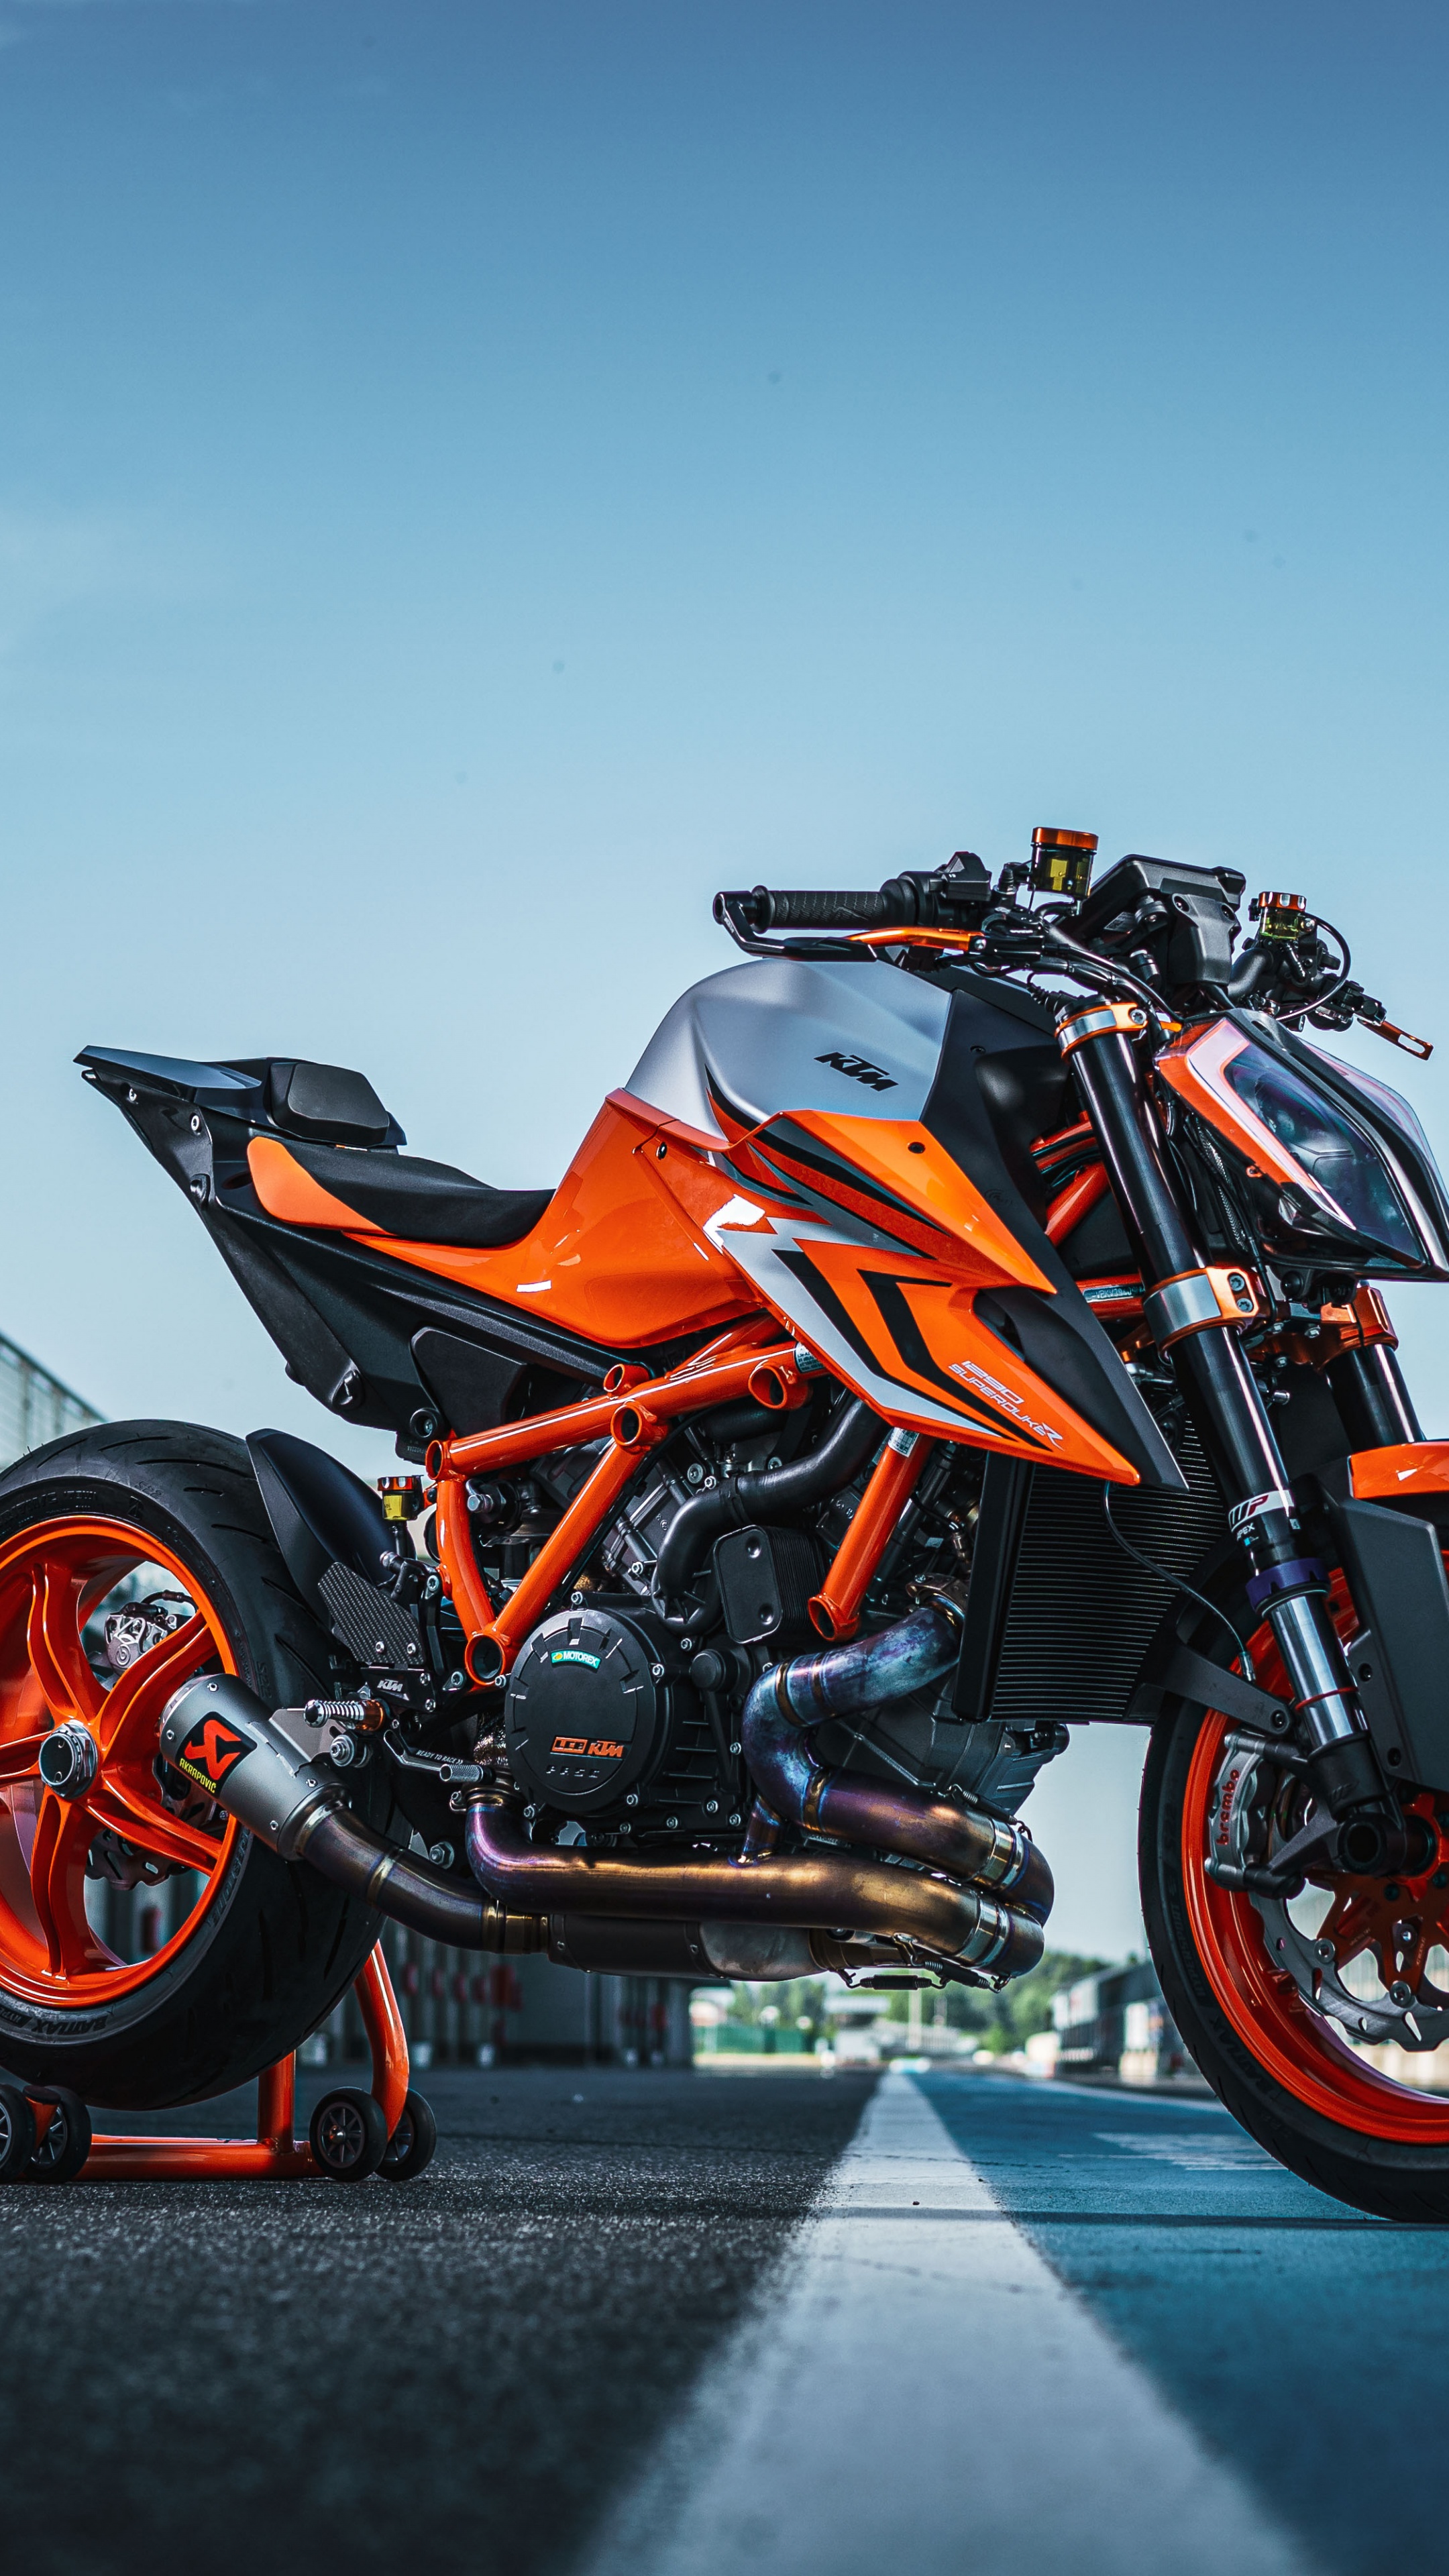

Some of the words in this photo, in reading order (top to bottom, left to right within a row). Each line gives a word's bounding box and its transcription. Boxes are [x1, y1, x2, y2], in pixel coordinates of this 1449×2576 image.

[813, 1052, 899, 1091] KTM
[961, 1360, 1024, 1404] 1290
[563, 1650, 598, 1667] MOTOREX
[377, 1679, 403, 1692] KTM
[416, 1750, 435, 1758] READY
[441, 1755, 458, 1764] RACE
[588, 1740, 624, 1757] KTM
[1216, 1769, 1240, 1845] brembo
